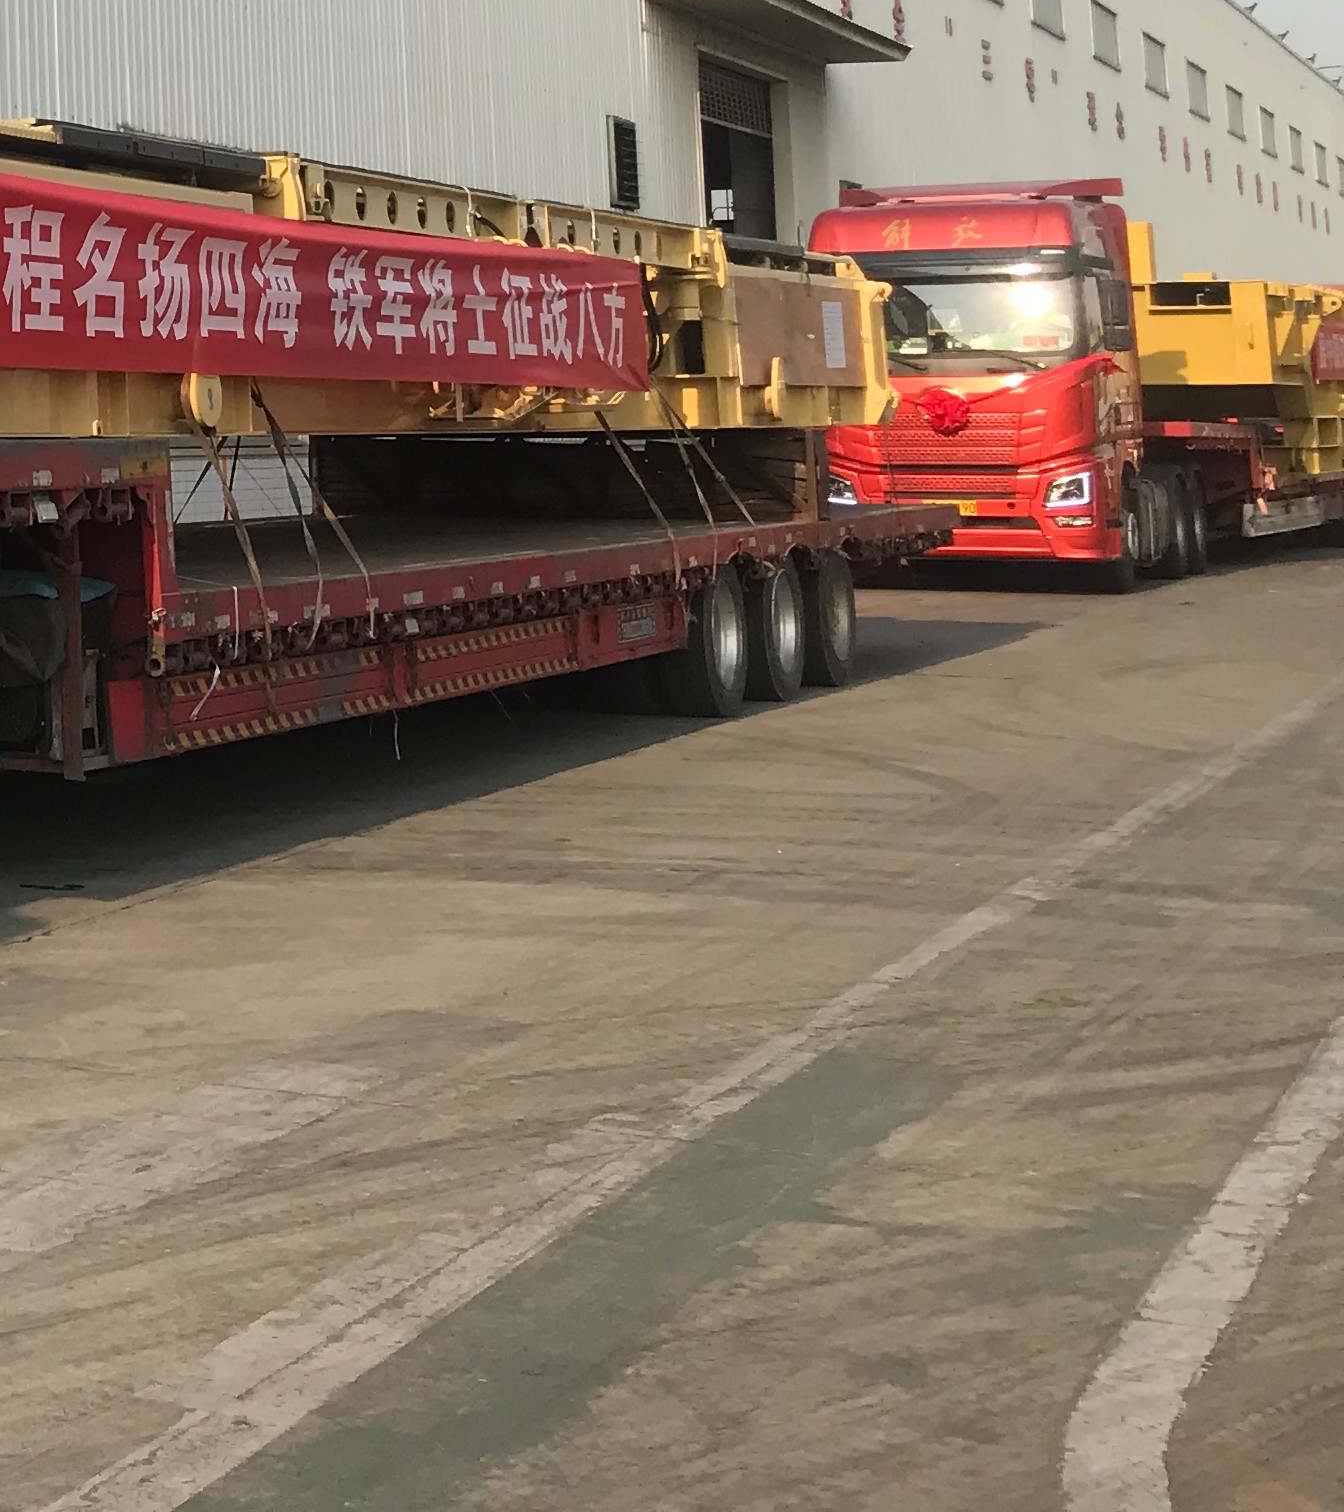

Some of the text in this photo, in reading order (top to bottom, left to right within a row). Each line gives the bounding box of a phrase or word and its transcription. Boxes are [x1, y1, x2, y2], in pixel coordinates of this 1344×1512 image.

[328, 246, 626, 368] 铁军将士征战八方
